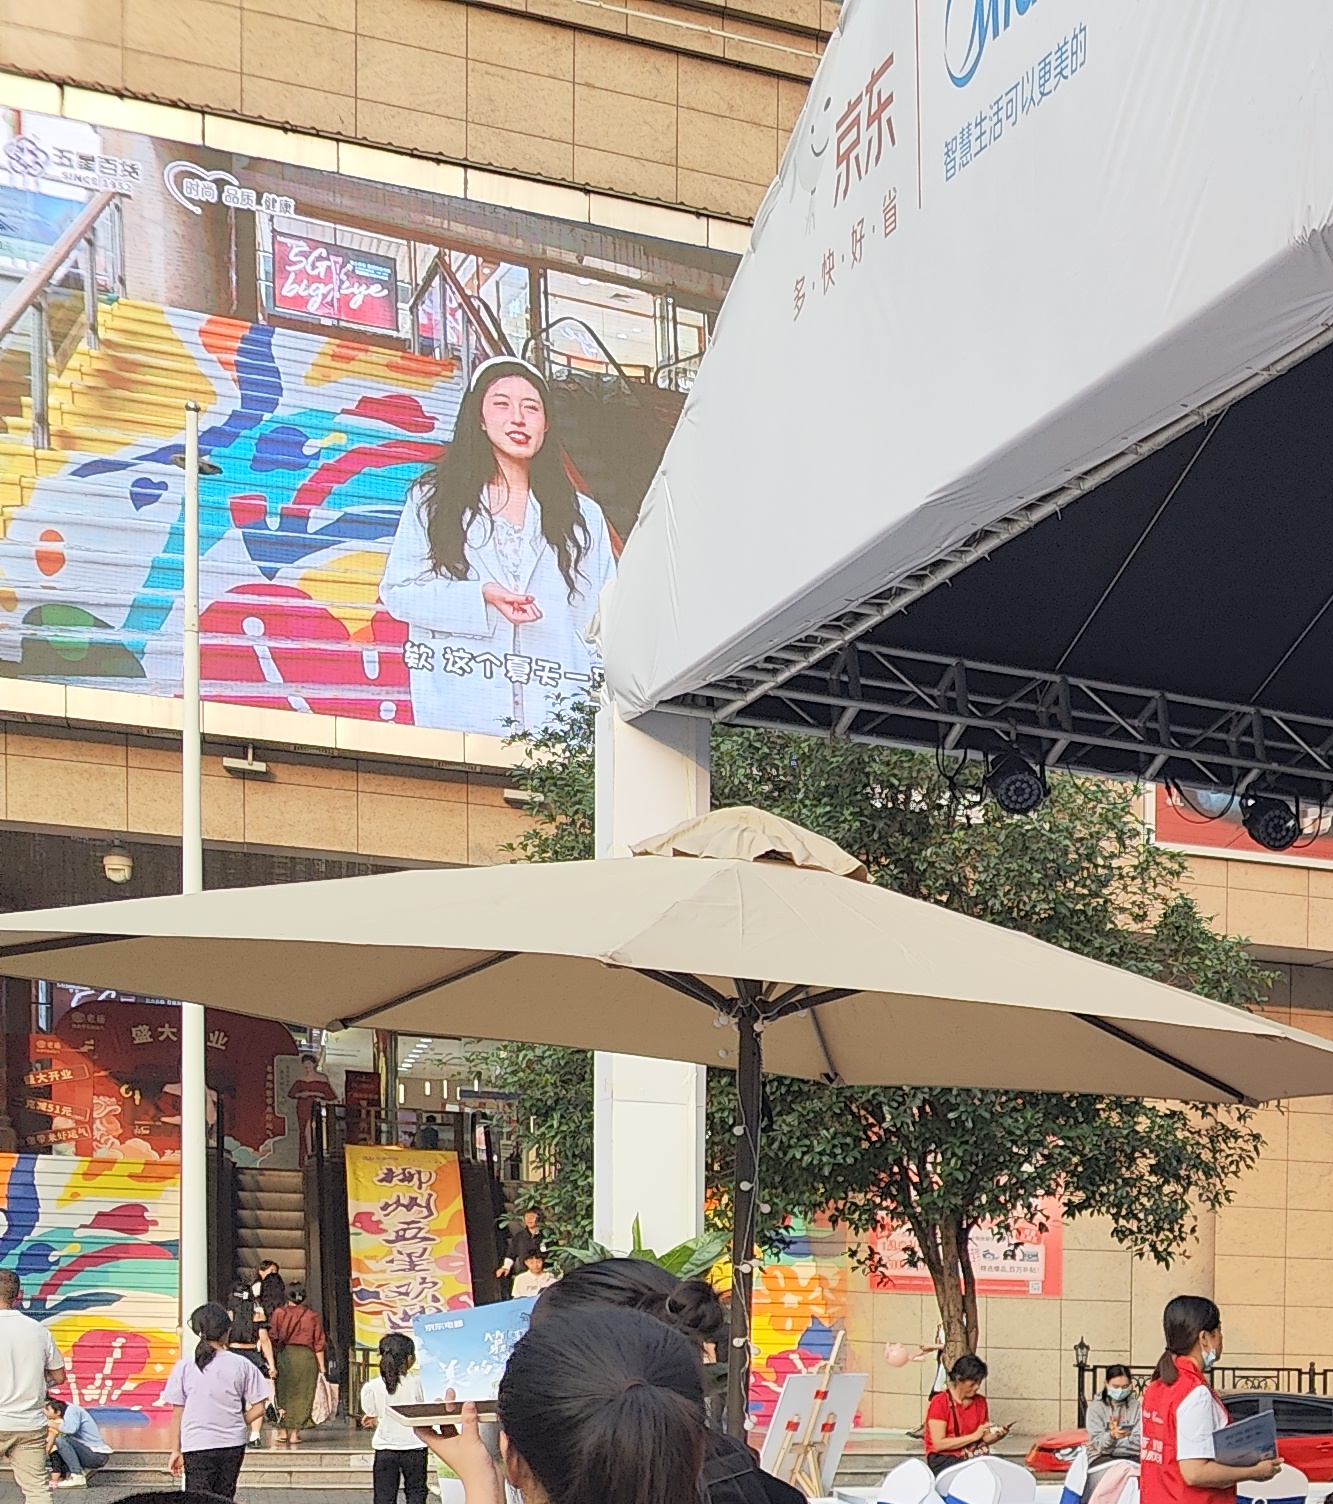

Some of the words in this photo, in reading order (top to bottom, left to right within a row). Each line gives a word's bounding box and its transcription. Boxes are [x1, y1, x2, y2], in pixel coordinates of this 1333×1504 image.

[943, 22, 1087, 182] 智慧生活可以更美的
[834, 52, 896, 208] 京东
[61, 171, 99, 187] SINCE
[183, 179, 217, 202] 时尚
[223, 187, 256, 208] 品质
[277, 236, 331, 278] 5G
[443, 647, 604, 688] 这个夏天一
[131, 1023, 228, 1051] 盛大业
